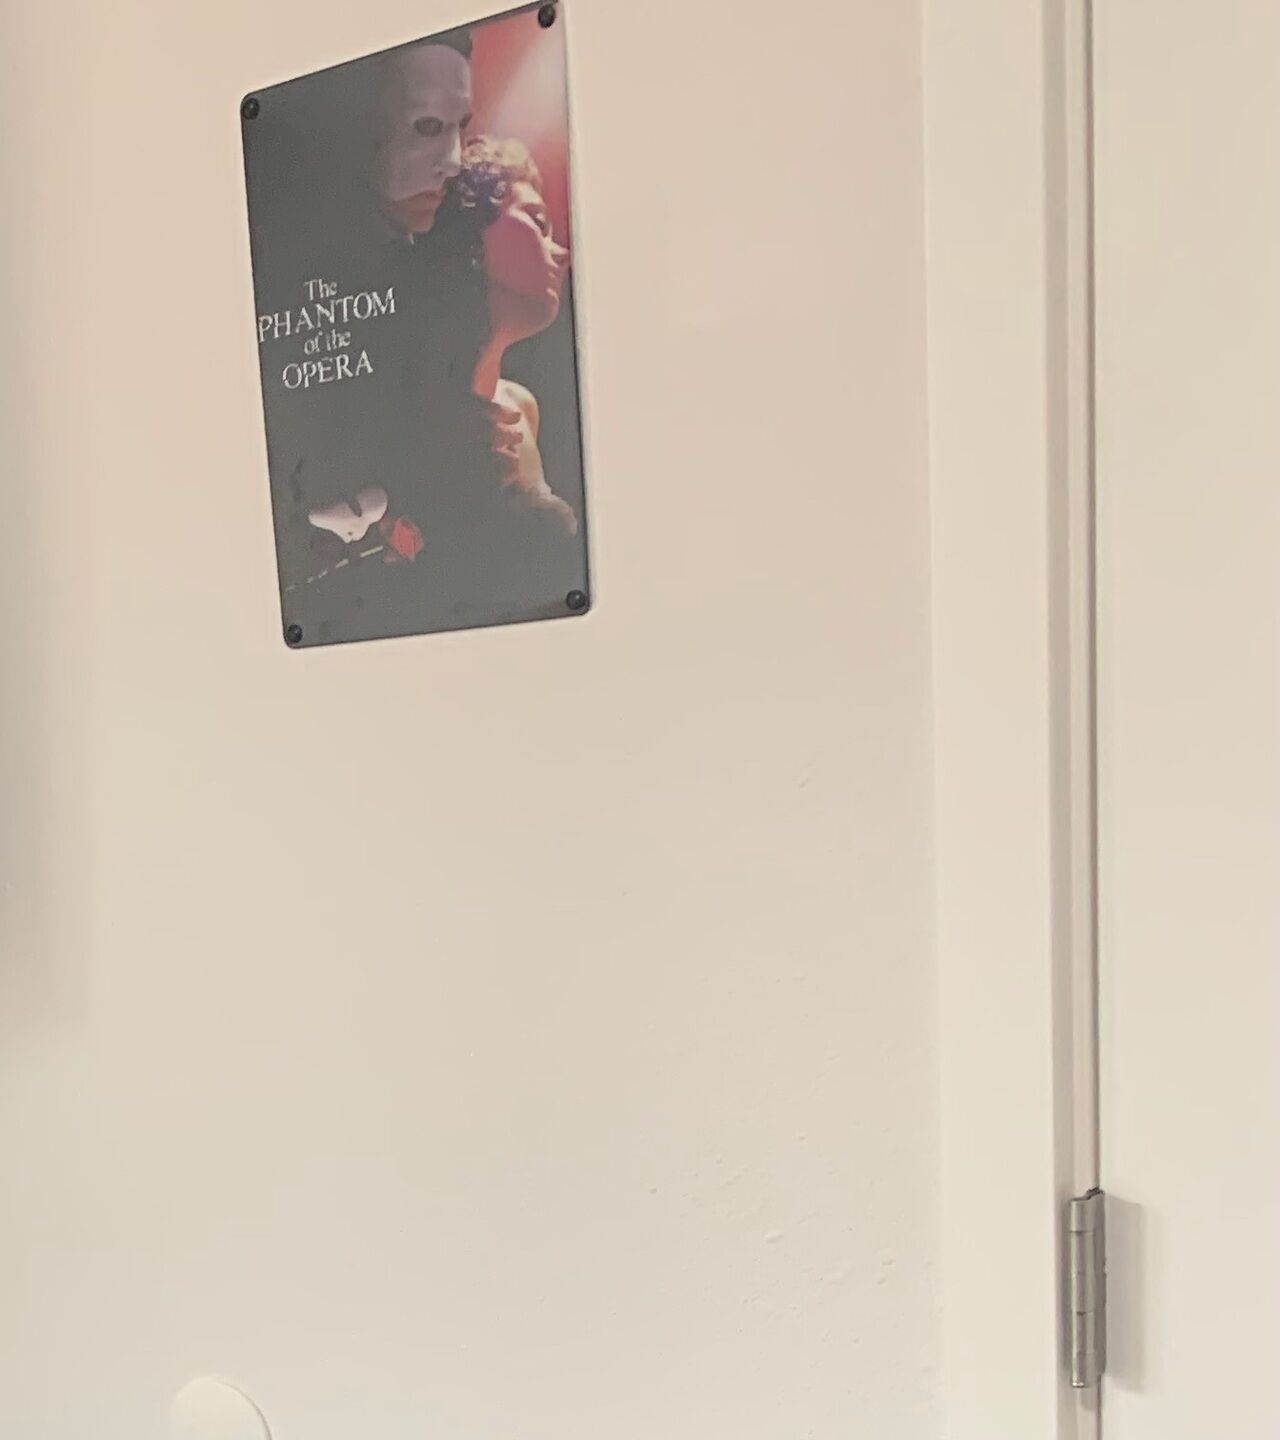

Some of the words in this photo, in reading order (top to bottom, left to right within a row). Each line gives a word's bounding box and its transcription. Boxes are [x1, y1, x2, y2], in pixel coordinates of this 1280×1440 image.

[304, 278, 338, 301] The
[258, 287, 396, 343] PHANTOM
[303, 330, 323, 355] of
[325, 328, 352, 351] the
[282, 349, 374, 389] OPERA
